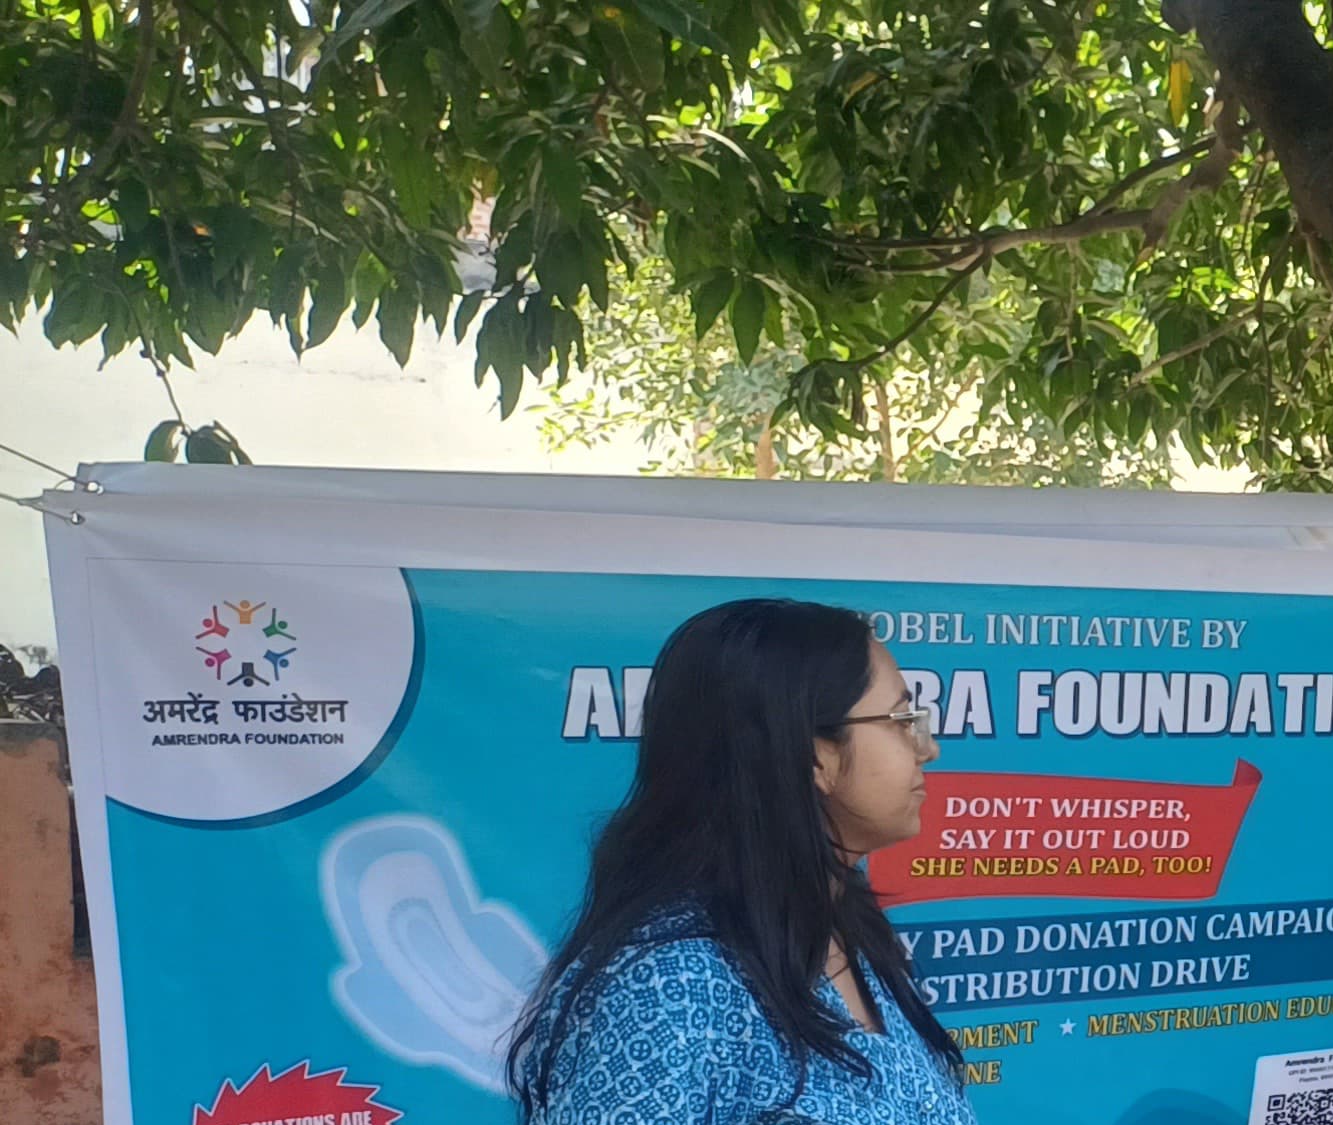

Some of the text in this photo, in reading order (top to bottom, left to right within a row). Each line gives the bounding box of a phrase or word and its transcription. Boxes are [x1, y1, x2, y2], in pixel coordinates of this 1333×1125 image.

[866, 611, 1248, 650] OBEL INITIATIVE BY
[143, 691, 349, 725] अमरेंद्र फाउंडेशन
[152, 733, 344, 746] AMRENDRA FOUNDATION
[945, 797, 1192, 821] DON'T WHISPER,
[939, 829, 1190, 850] SAY IT OUT LOUD
[910, 856, 1212, 877] SHE NEEDS A PAD, TOO!
[932, 927, 1005, 959] PAD
[1015, 915, 1198, 954] DONATION
[914, 954, 1251, 1007] STRIBUTION DRIVE
[1086, 1000, 1281, 1038] MENSTRUATION
[961, 1060, 1002, 1086] NE
